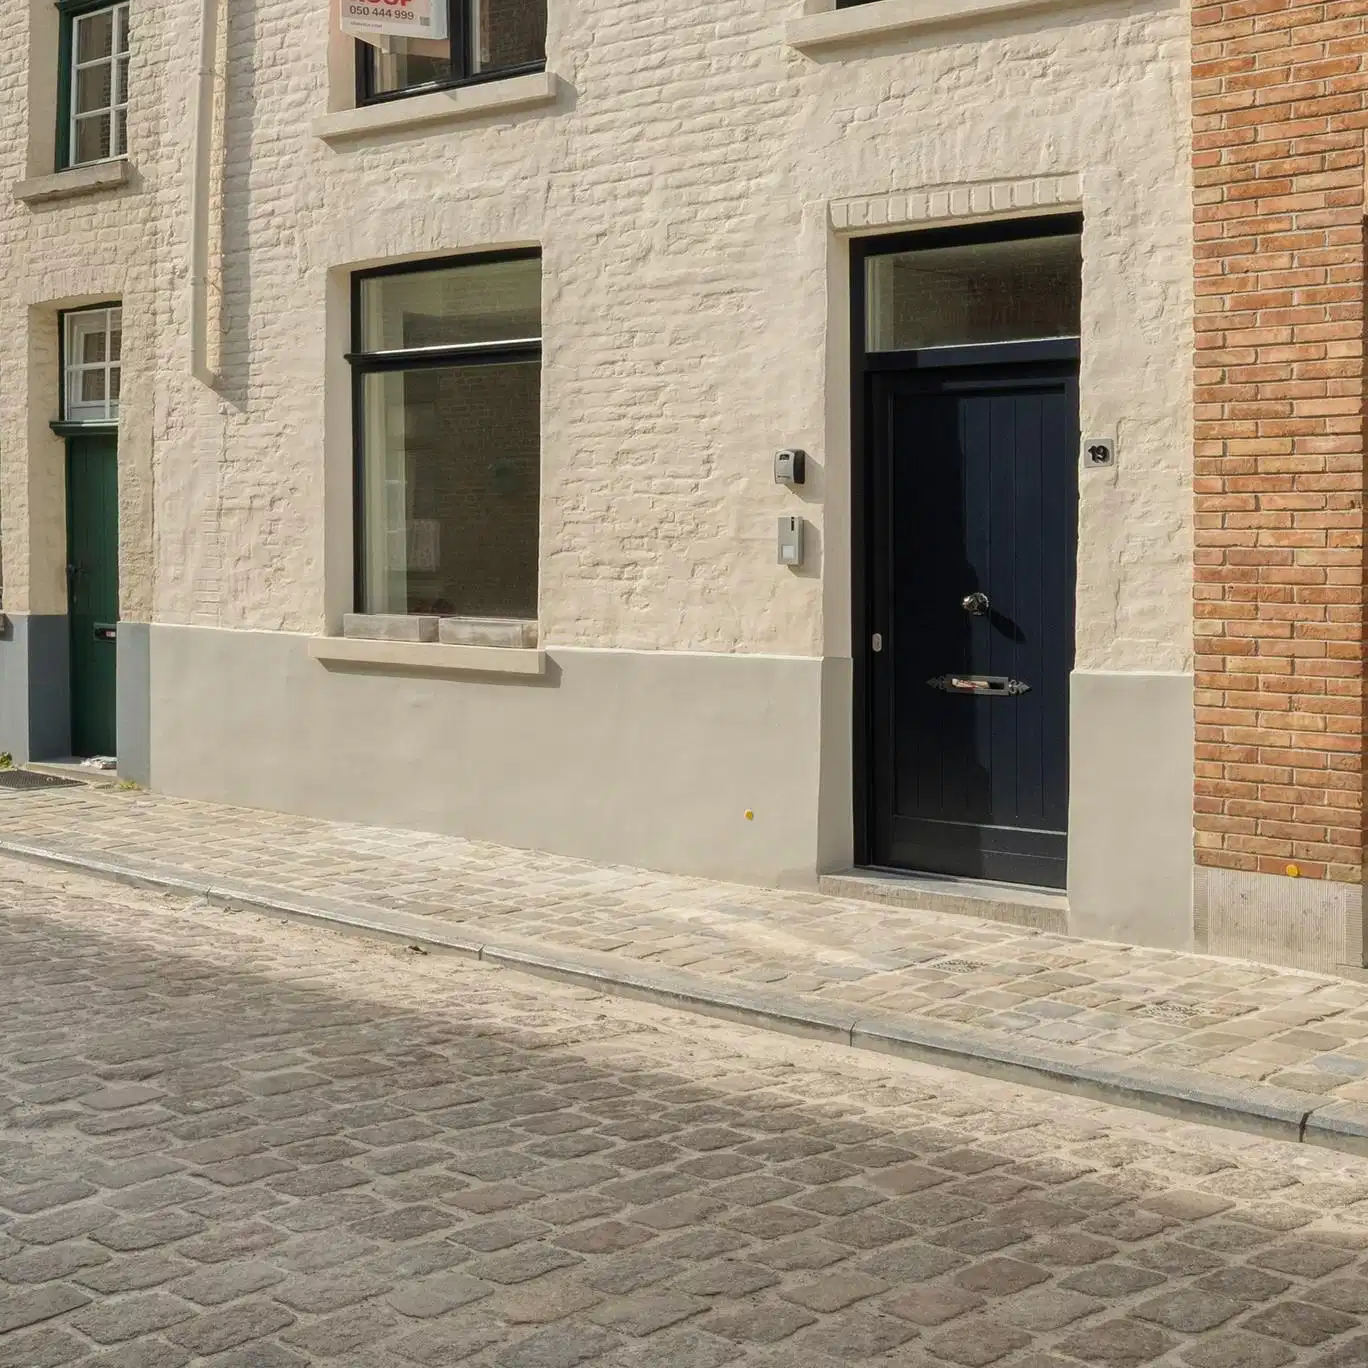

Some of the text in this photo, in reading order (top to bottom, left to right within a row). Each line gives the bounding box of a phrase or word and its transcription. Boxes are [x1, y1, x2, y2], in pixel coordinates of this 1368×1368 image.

[349, 5, 414, 21] 050 444 999
[1088, 445, 1110, 463] 19
